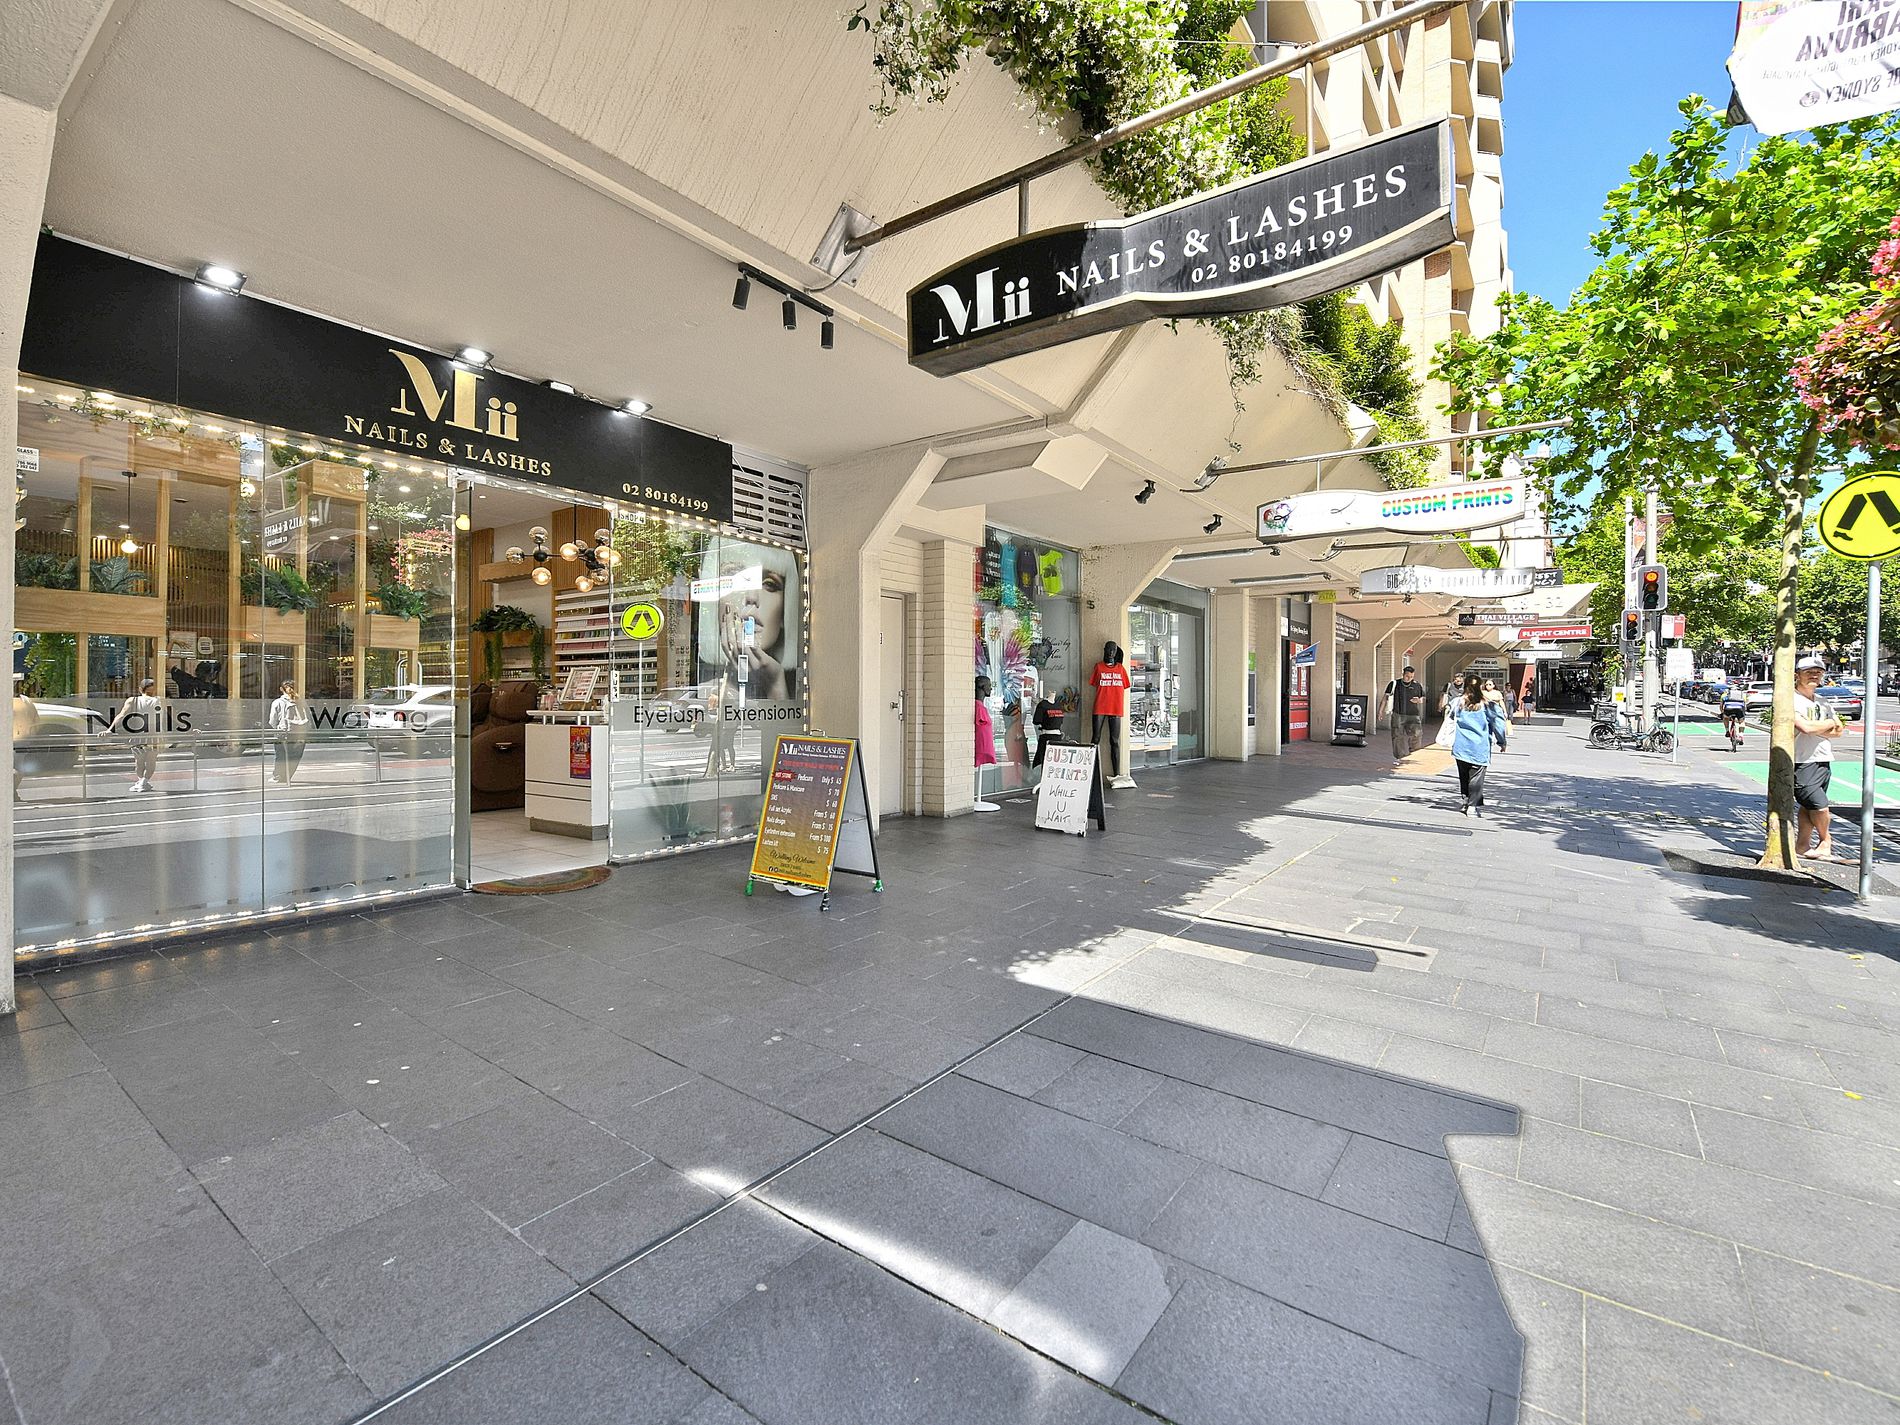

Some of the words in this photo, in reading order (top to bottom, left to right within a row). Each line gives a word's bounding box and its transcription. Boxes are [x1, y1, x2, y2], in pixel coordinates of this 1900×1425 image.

[1056, 238, 1166, 297] NAILS
[1183, 228, 1211, 258] &
[1227, 163, 1408, 247] LASHES
[1191, 262, 1219, 283] 02
[1228, 224, 1354, 272] 80184199
[929, 265, 1033, 345] Mii
[388, 348, 520, 442] Mii
[343, 414, 428, 449] NAILS
[438, 438, 455, 456] &
[464, 443, 552, 477] LASHES
[622, 482, 640, 496] 02
[644, 486, 709, 512] 80184199
[1382, 494, 1447, 518] CUSTOM
[1452, 486, 1513, 511] PRINTS
[86, 704, 193, 734] Nails
[308, 705, 430, 733] Wang
[633, 705, 705, 727] Eyelash
[724, 704, 802, 722] Extensions
[798, 744, 815, 753] NAILS
[823, 746, 847, 755] LASHES
[1045, 747, 1094, 766] CUSTOM
[1046, 765, 1089, 781] PRINTS
[1048, 784, 1078, 798] WHILE
[1046, 809, 1071, 823] WAIT
[1056, 800, 1067, 813] U
